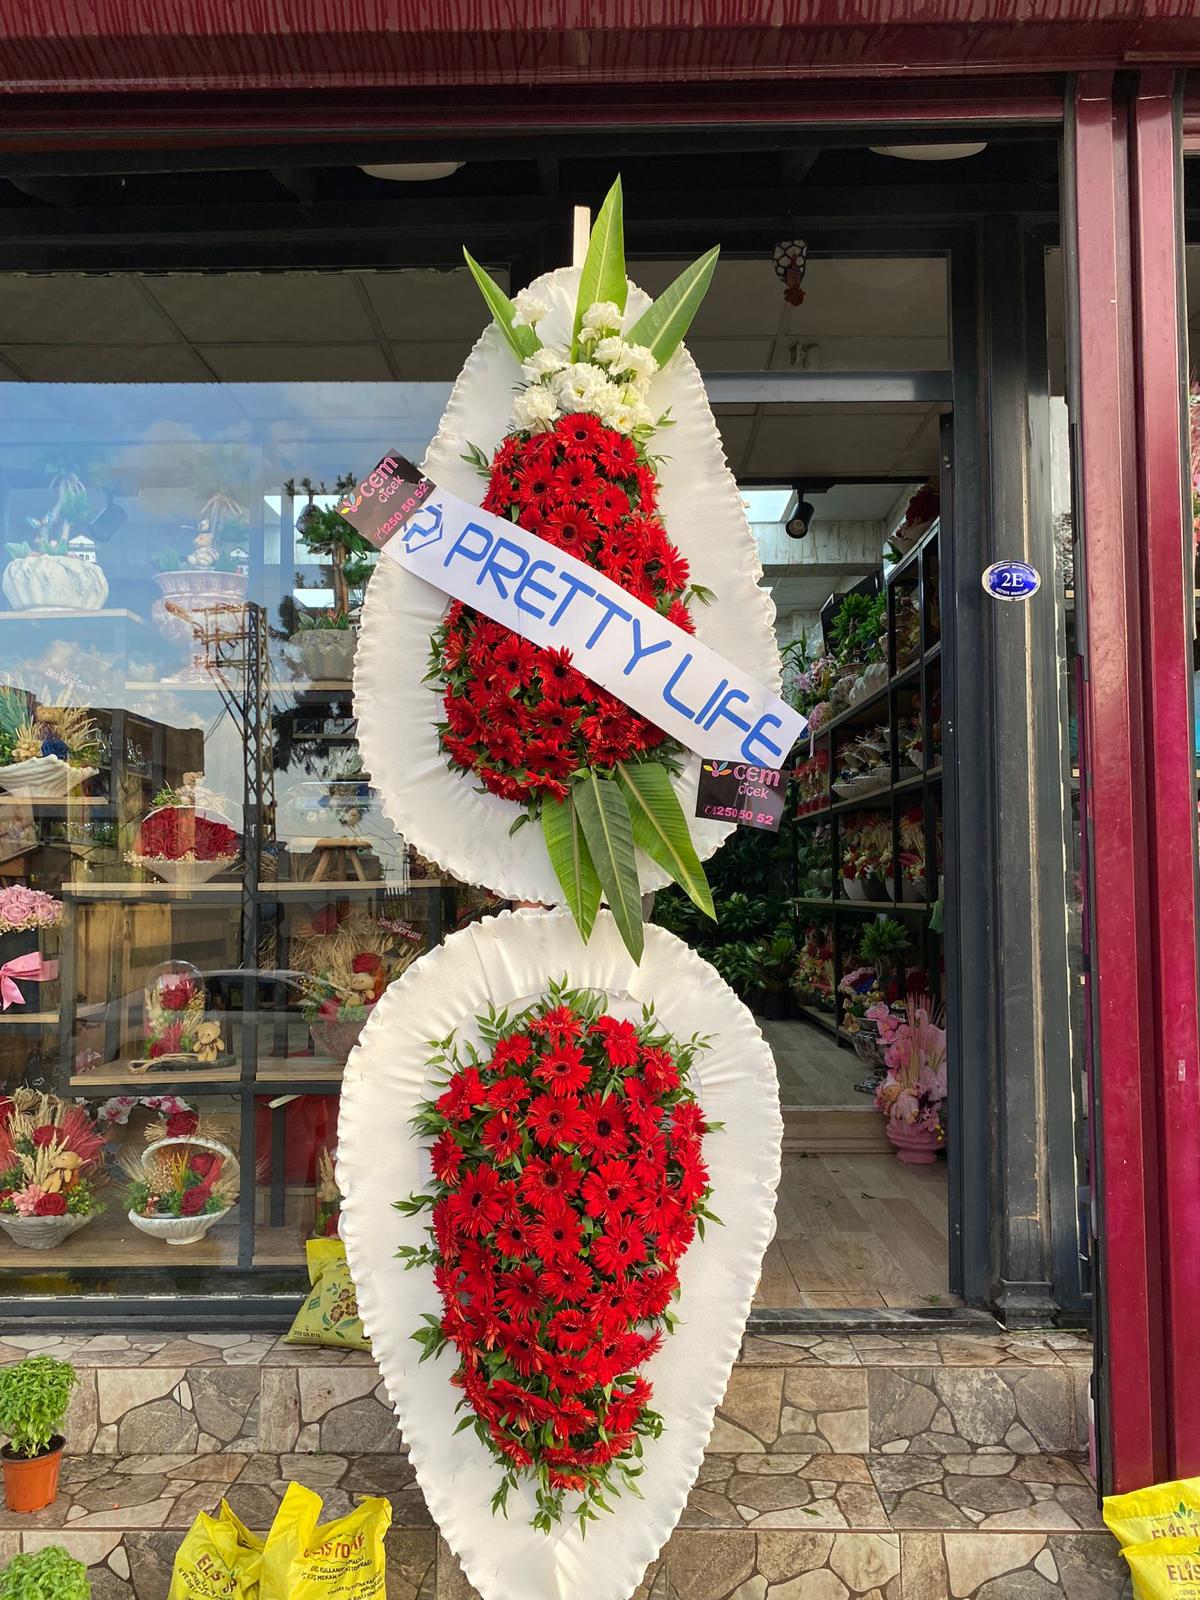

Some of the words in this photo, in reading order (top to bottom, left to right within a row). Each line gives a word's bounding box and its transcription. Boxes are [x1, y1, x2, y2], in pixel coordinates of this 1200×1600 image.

[1001, 572, 1025, 588] 2E
[443, 521, 672, 676] PRETTY
[662, 653, 783, 768] LIFE
[756, 813, 774, 826] 52
